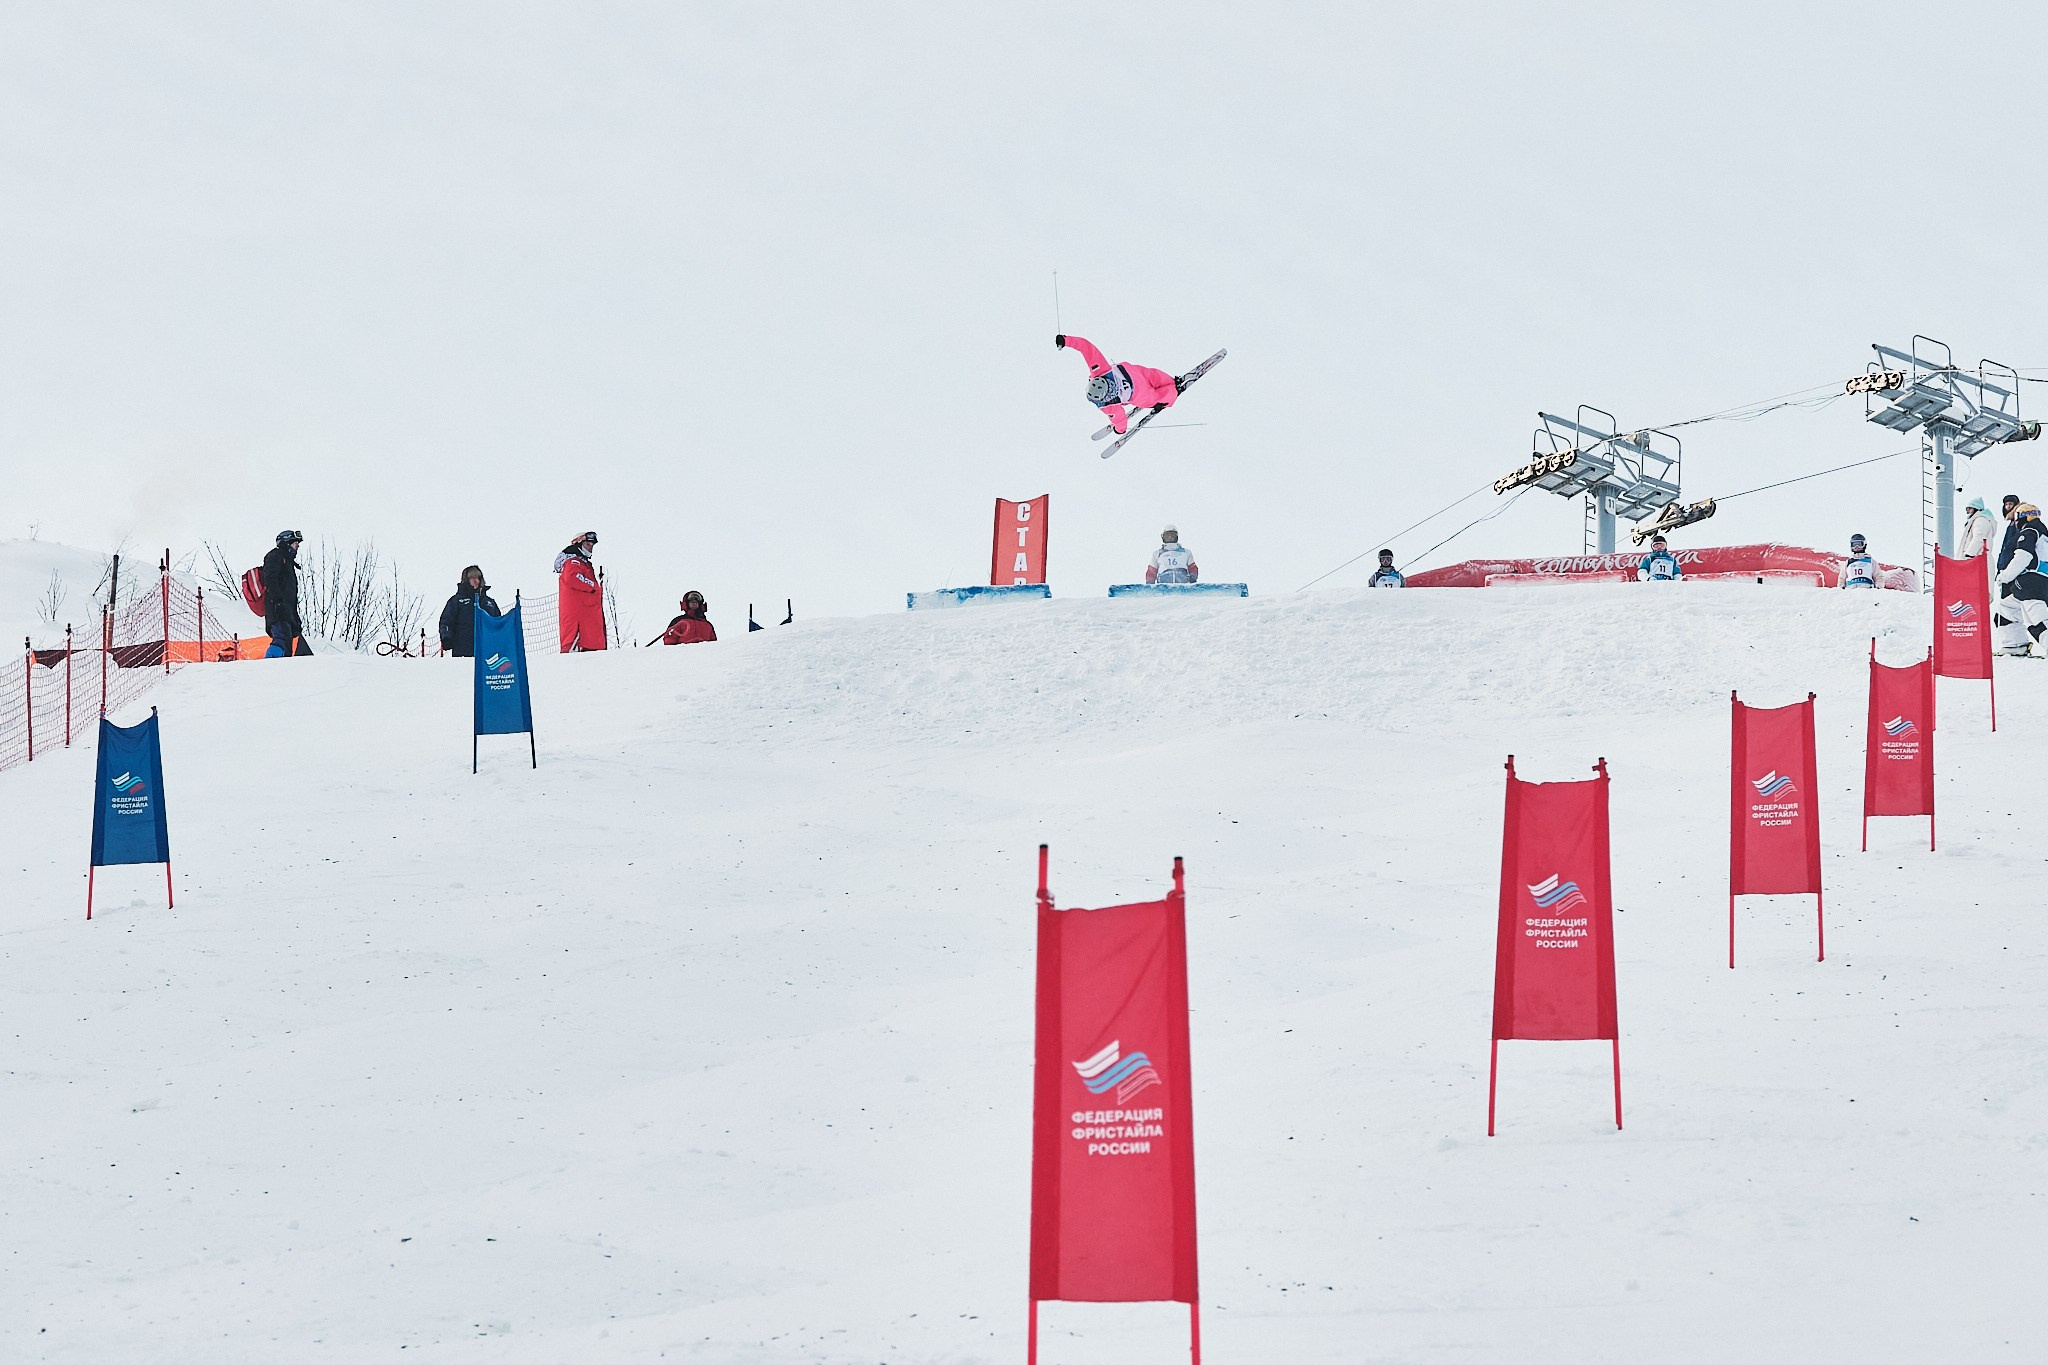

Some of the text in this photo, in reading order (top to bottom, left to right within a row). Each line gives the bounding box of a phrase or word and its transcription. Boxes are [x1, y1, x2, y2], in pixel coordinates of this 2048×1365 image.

[1167, 558, 1178, 566] 16
[1659, 565, 1666, 573] 11
[1854, 568, 1863, 576] 10
[111, 795, 149, 803] ФЕДЕРАЦИЯ
[1751, 802, 1799, 811] ФЕДЕРАЦИЯ
[1751, 810, 1799, 819] ФРИСТАЙЛА
[1760, 818, 1792, 827] РОССИИ
[1525, 917, 1588, 927] ФЕДЕРАЦИЯ
[1525, 927, 1588, 938] ФРИСТАЙЛА
[1536, 939, 1579, 949] РОССИИ
[1071, 1107, 1163, 1124] ФЕДЕРАЦИЯ
[1071, 1122, 1164, 1140] ФРИСТАЙЛА
[1088, 1141, 1151, 1156] РОССИИ
